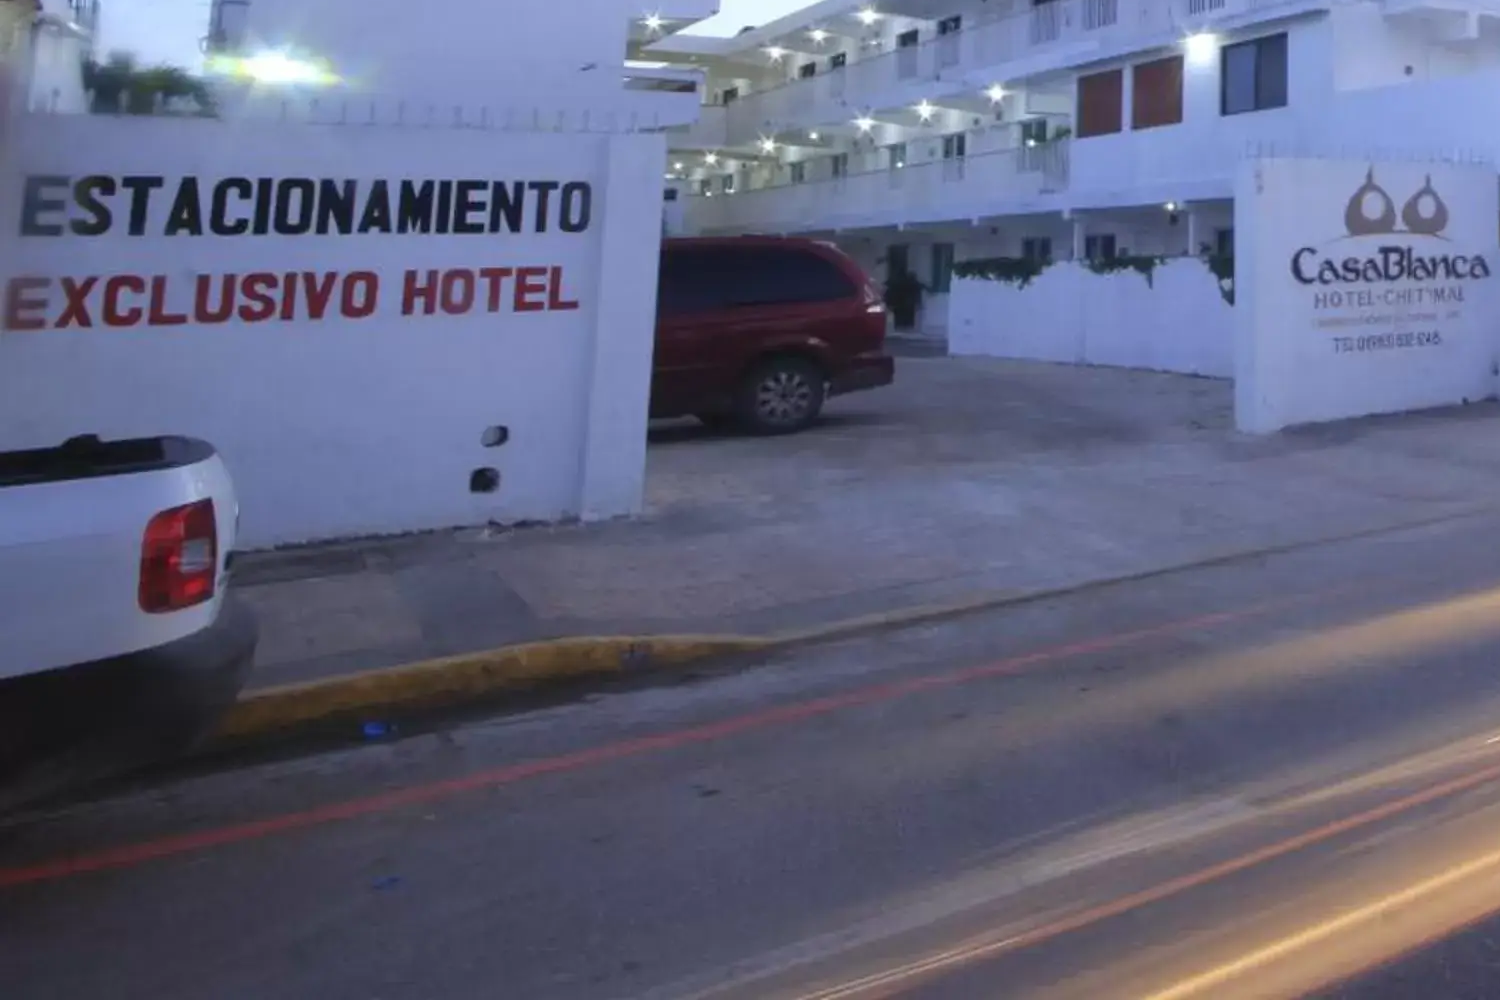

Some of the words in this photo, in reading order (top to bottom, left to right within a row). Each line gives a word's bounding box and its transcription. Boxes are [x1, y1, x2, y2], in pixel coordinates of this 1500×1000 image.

[19, 174, 593, 237] ESTACIONAMIENTO
[1291, 245, 1491, 285] CasaBlanca
[4, 270, 380, 331] EXCLUSIVO
[401, 266, 580, 316] HOTEL
